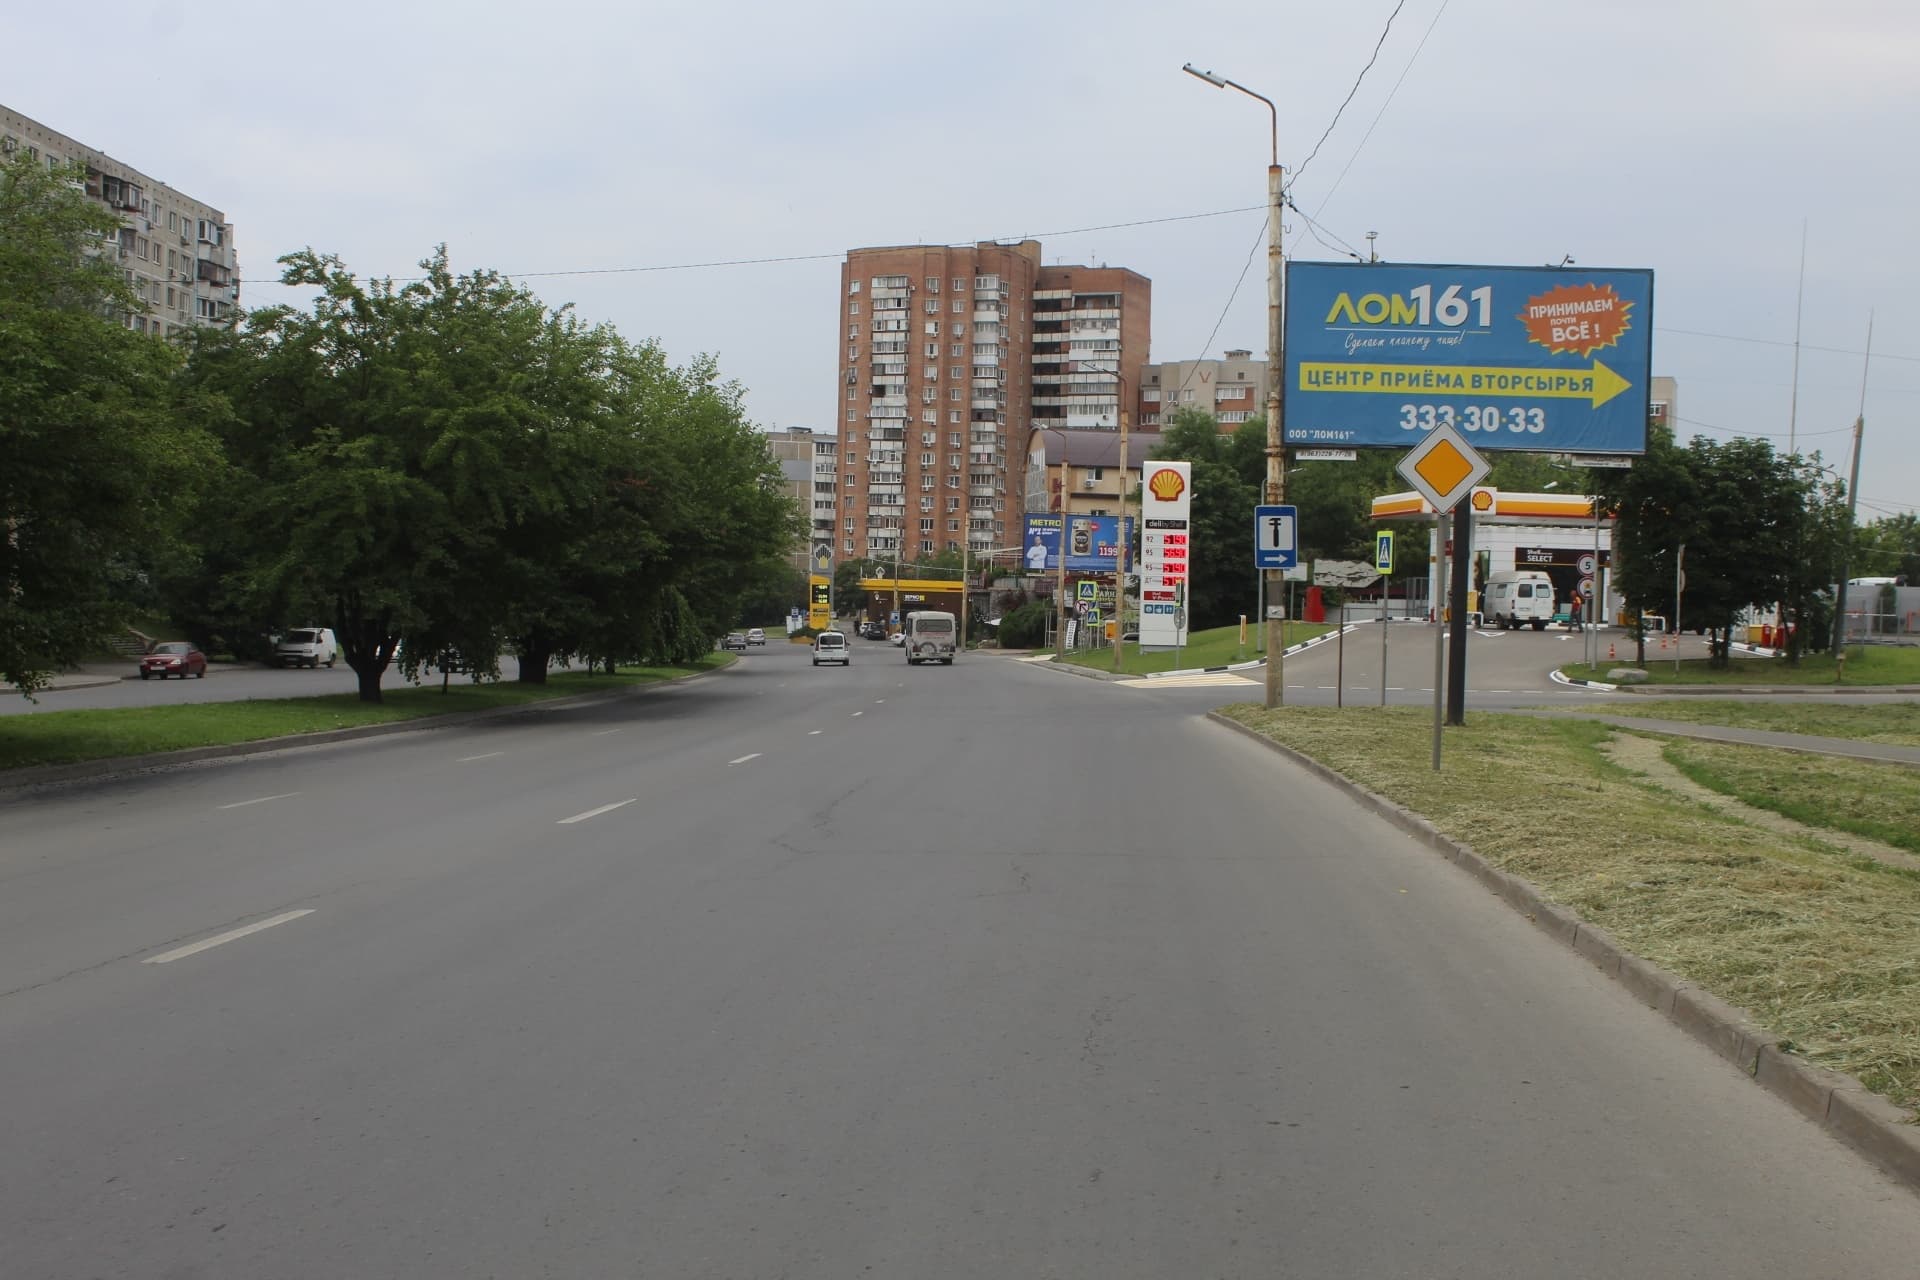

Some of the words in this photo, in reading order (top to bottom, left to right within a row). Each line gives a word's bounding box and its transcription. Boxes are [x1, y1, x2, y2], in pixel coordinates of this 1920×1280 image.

[1325, 284, 1492, 327] ЛОМ161
[1529, 299, 1613, 319] ПРИНИМАЕМ
[1552, 321, 1590, 342] ВСЁ
[1307, 370, 1374, 387] ЦЕНТР
[1380, 369, 1464, 388] ПРИЁМА
[1471, 374, 1593, 392] ВТОРСЫРЬЯ
[1289, 430, 1307, 438] ООО
[1029, 519, 1061, 527] METRO
[1527, 555, 1553, 563] SELECT
[1585, 561, 1591, 570] 5
